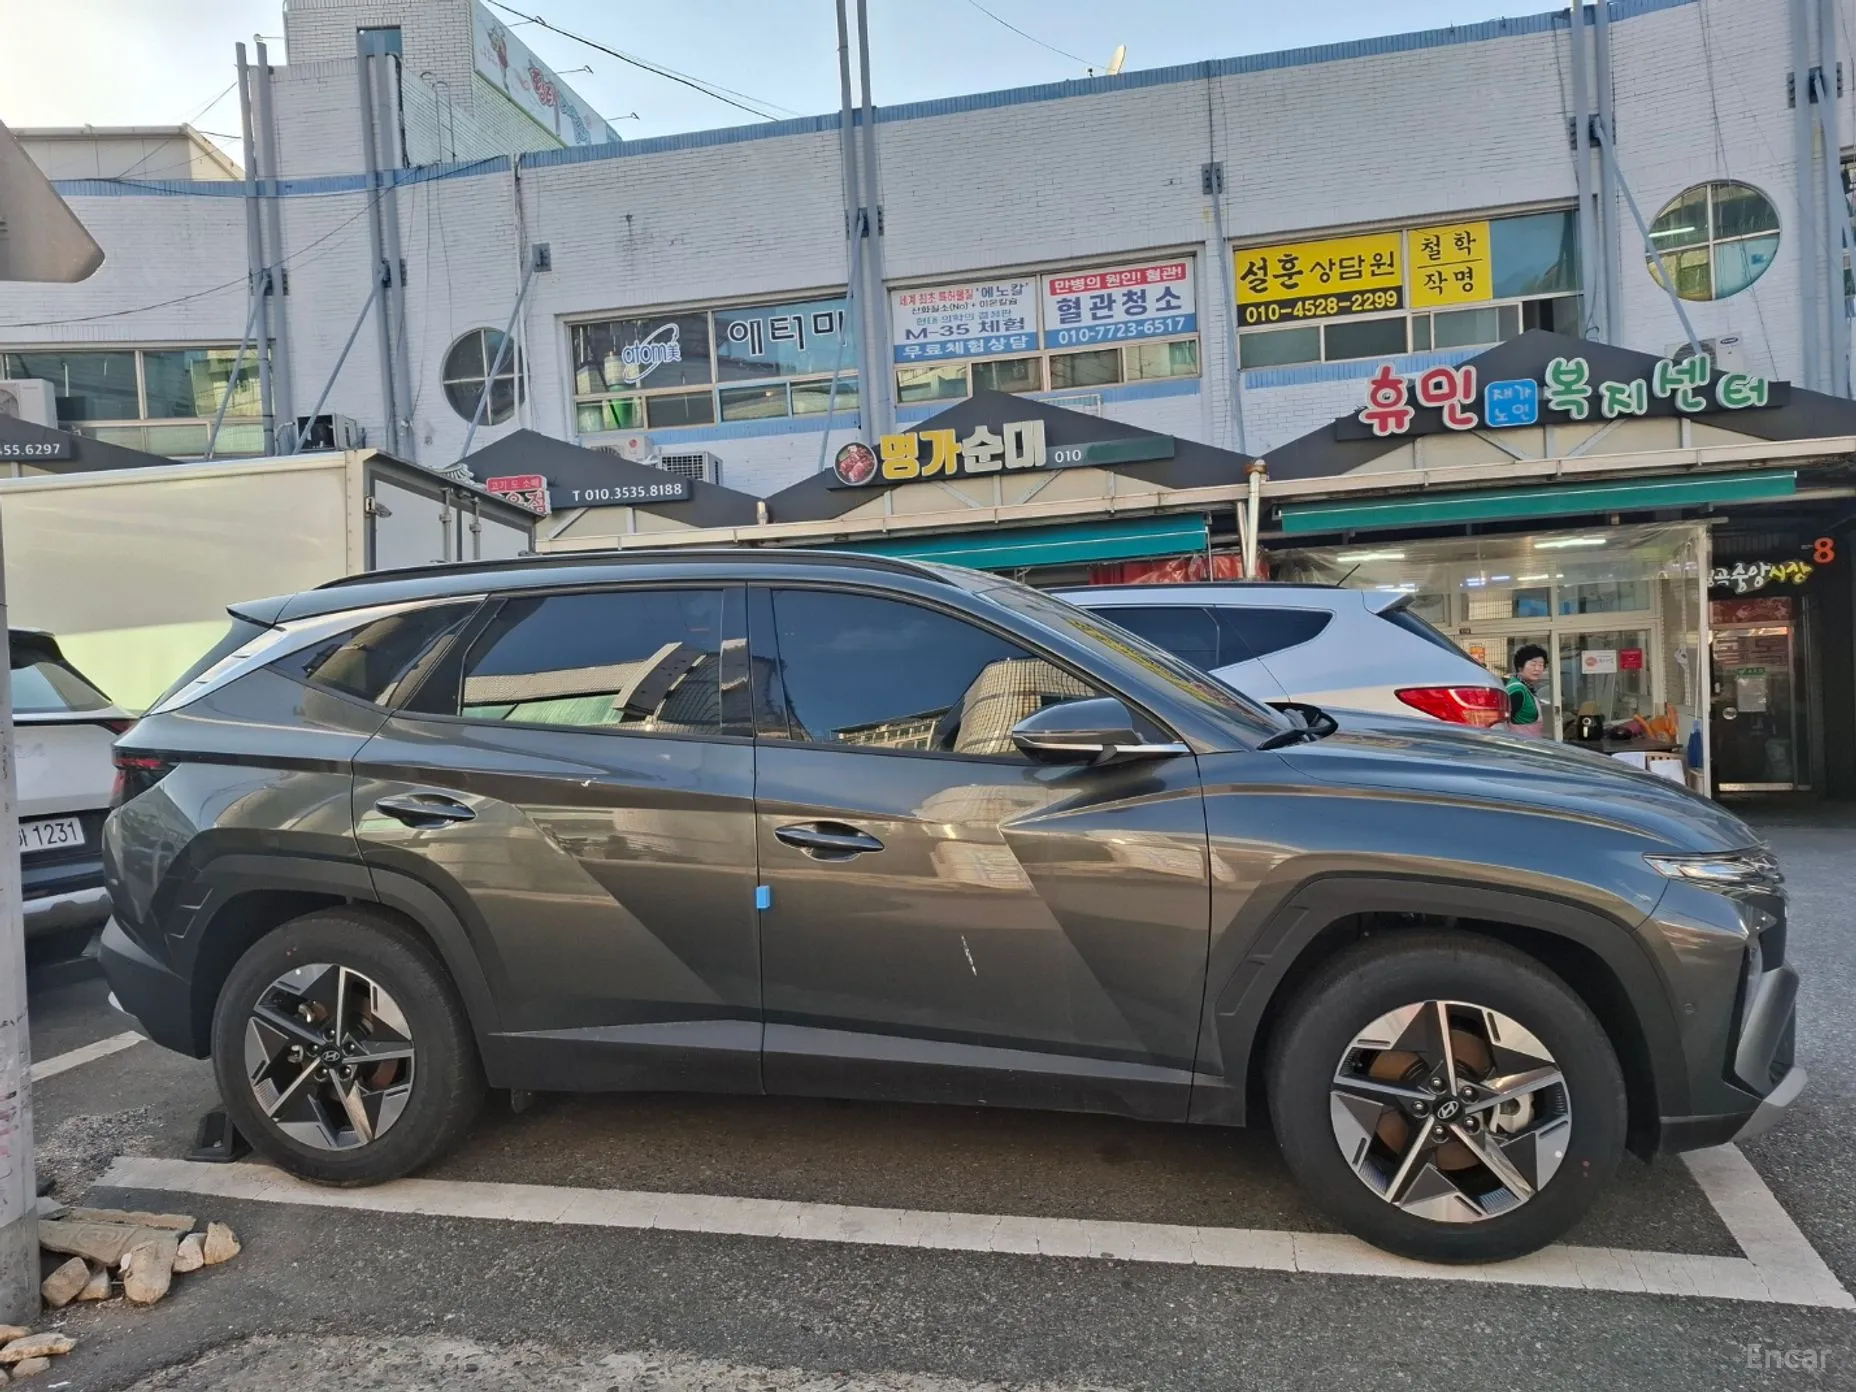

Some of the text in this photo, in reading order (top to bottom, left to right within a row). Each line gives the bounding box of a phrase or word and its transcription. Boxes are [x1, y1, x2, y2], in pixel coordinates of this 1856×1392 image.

[1421, 230, 1477, 261] 철학
[1054, 266, 1182, 293] 만병의 원인! 혈관!
[1309, 250, 1396, 284] 상담원
[1423, 266, 1474, 297] 작명
[1056, 285, 1182, 325] 혈관청소
[1245, 290, 1398, 323] 010-4528-2299
[905, 317, 1025, 340] M-35 체험
[1058, 317, 1185, 344] 010-7723-6517
[1359, 353, 1769, 437] 휴민 복지센터
[0, 443, 60, 456] 55.6297
[1055, 449, 1082, 463] 010
[572, 483, 682, 501] T 010.3535.8188
[1813, 536, 1835, 563] 8
[32, 821, 77, 846] 1231
